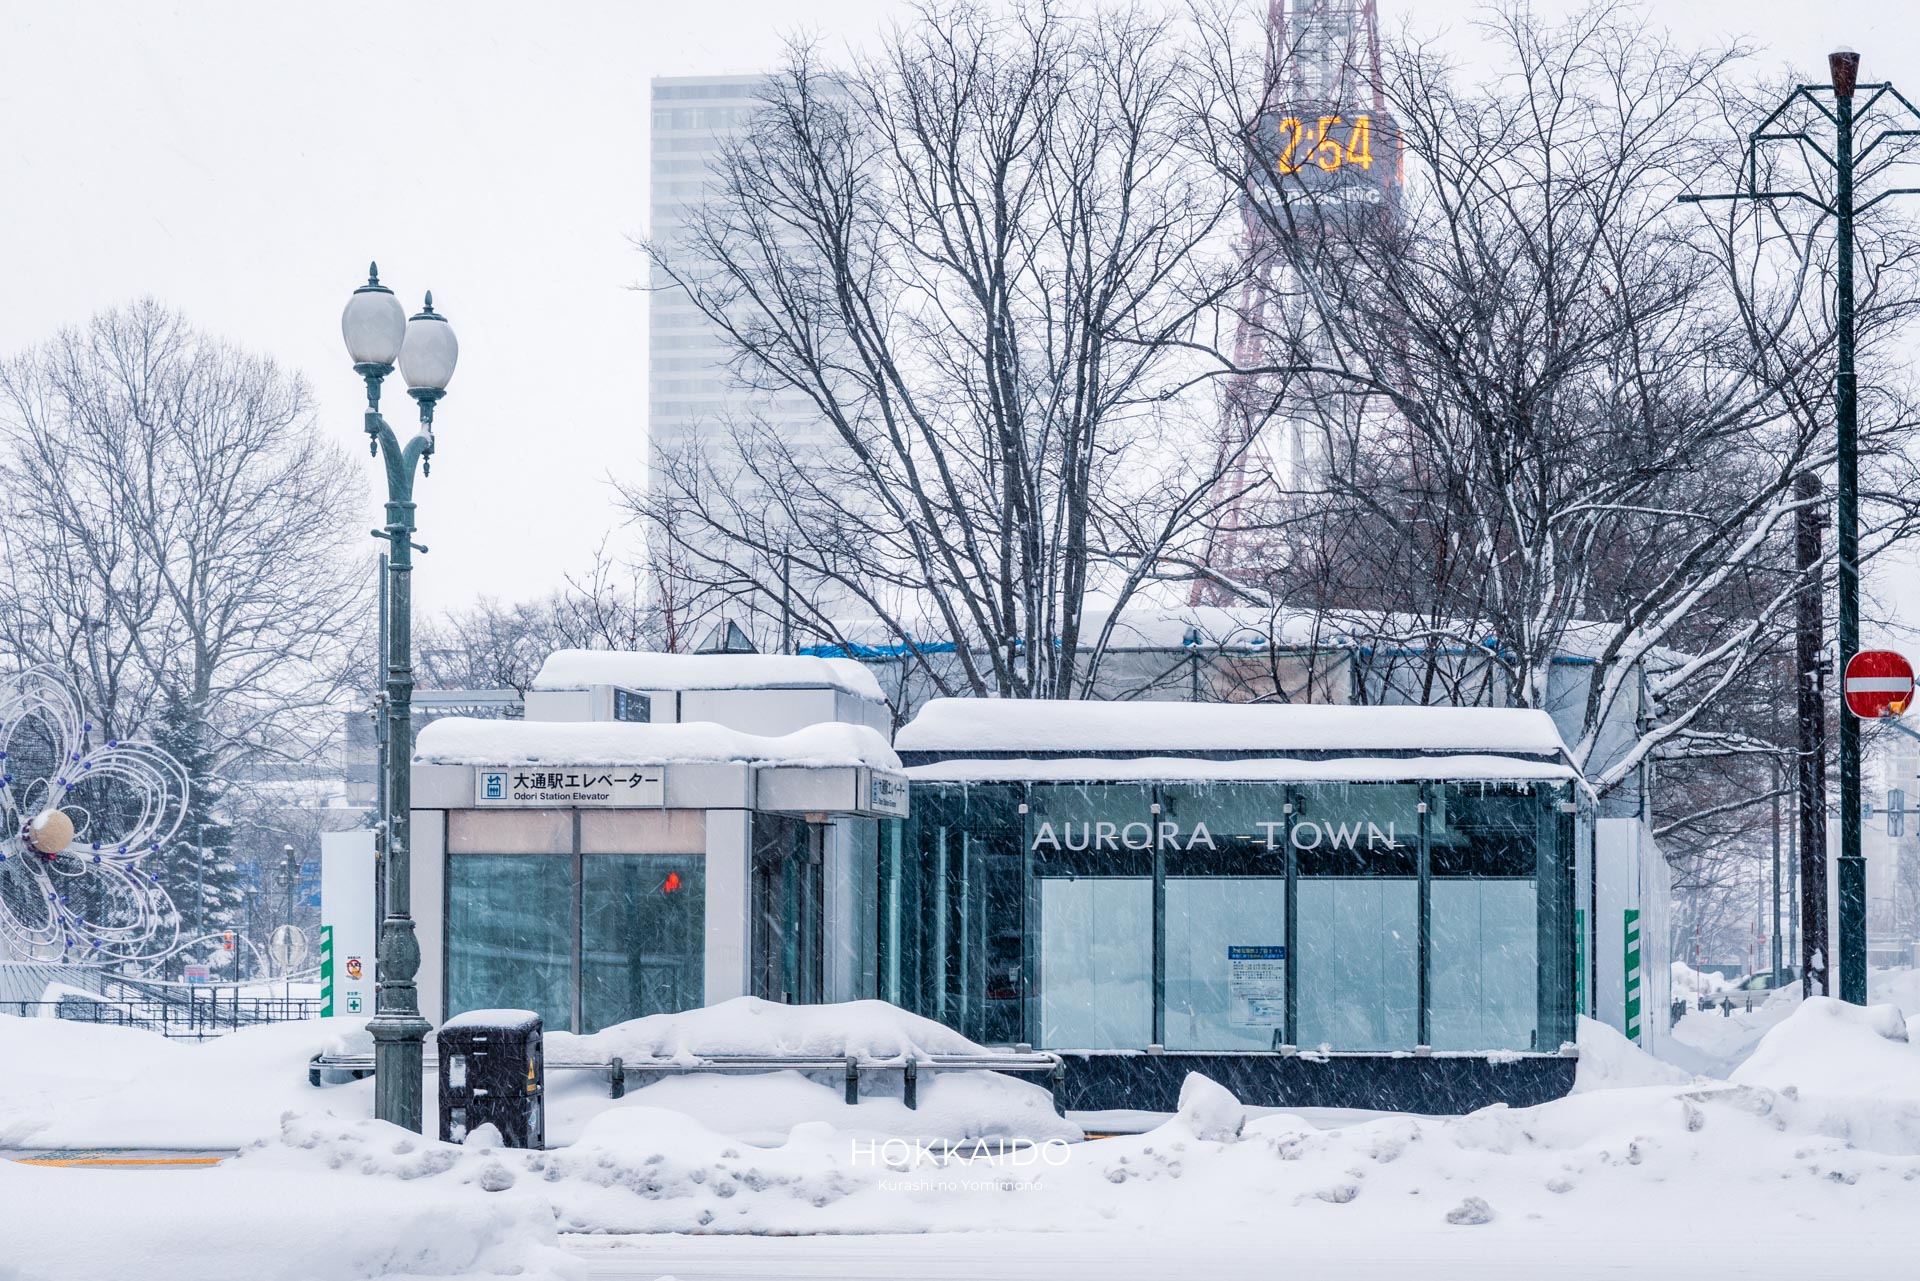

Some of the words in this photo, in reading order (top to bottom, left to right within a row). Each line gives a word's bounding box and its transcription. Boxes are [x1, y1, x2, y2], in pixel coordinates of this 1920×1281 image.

[1278, 115, 1373, 174] 2:54
[513, 772, 659, 790] 大通駅エレベーター
[514, 792, 538, 801] Odori
[539, 792, 571, 801] Station
[572, 792, 610, 801] Elevator
[1030, 820, 1217, 852] AURORA
[1255, 820, 1396, 852] TOWN
